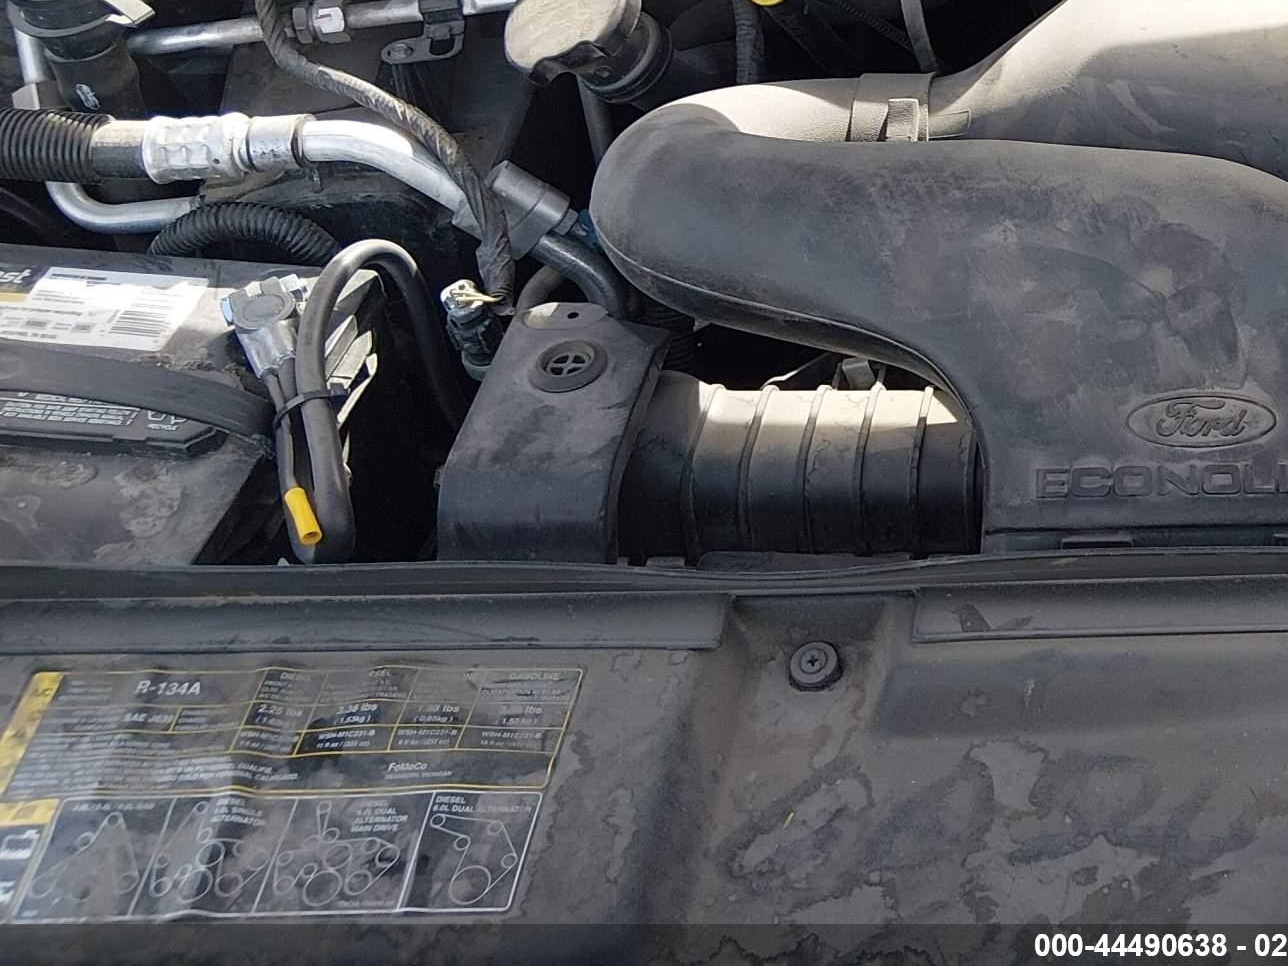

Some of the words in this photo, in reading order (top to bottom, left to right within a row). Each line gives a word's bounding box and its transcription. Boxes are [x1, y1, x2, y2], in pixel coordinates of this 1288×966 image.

[1155, 400, 1248, 438] Ford
[508, 672, 561, 681] GASOLINE
[134, 679, 202, 696] R-134A
[442, 705, 460, 713] lbs
[525, 705, 543, 714] lbs
[388, 762, 428, 772] FoMoCo
[435, 795, 466, 804] DIESEL
[375, 807, 397, 816] DUAL
[432, 804, 450, 812] 6.0L
[451, 804, 474, 813] DUAL
[353, 815, 408, 825] ALTERNATOR
